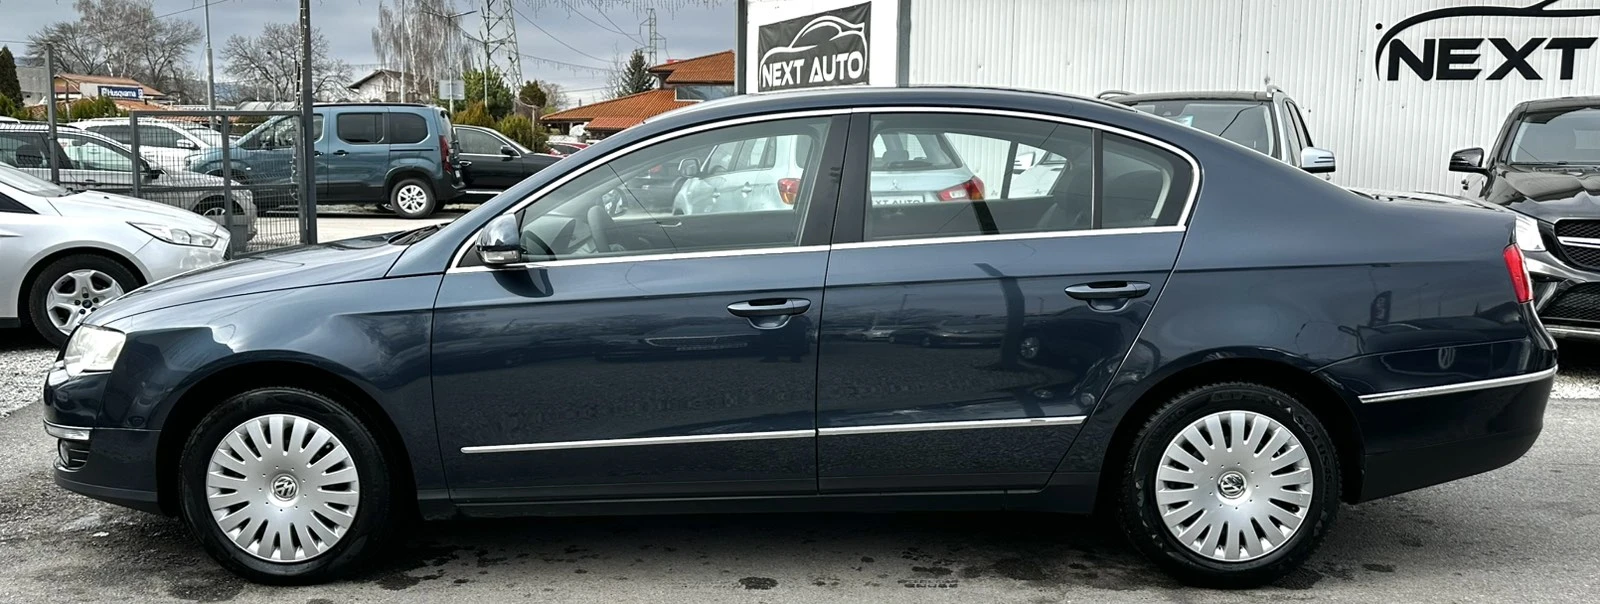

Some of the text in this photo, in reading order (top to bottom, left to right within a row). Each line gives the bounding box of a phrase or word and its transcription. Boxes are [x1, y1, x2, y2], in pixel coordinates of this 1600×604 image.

[762, 51, 863, 88] NEXT AUTO
[1387, 37, 1598, 81] NEXT
[107, 89, 136, 98] Husqvarna
